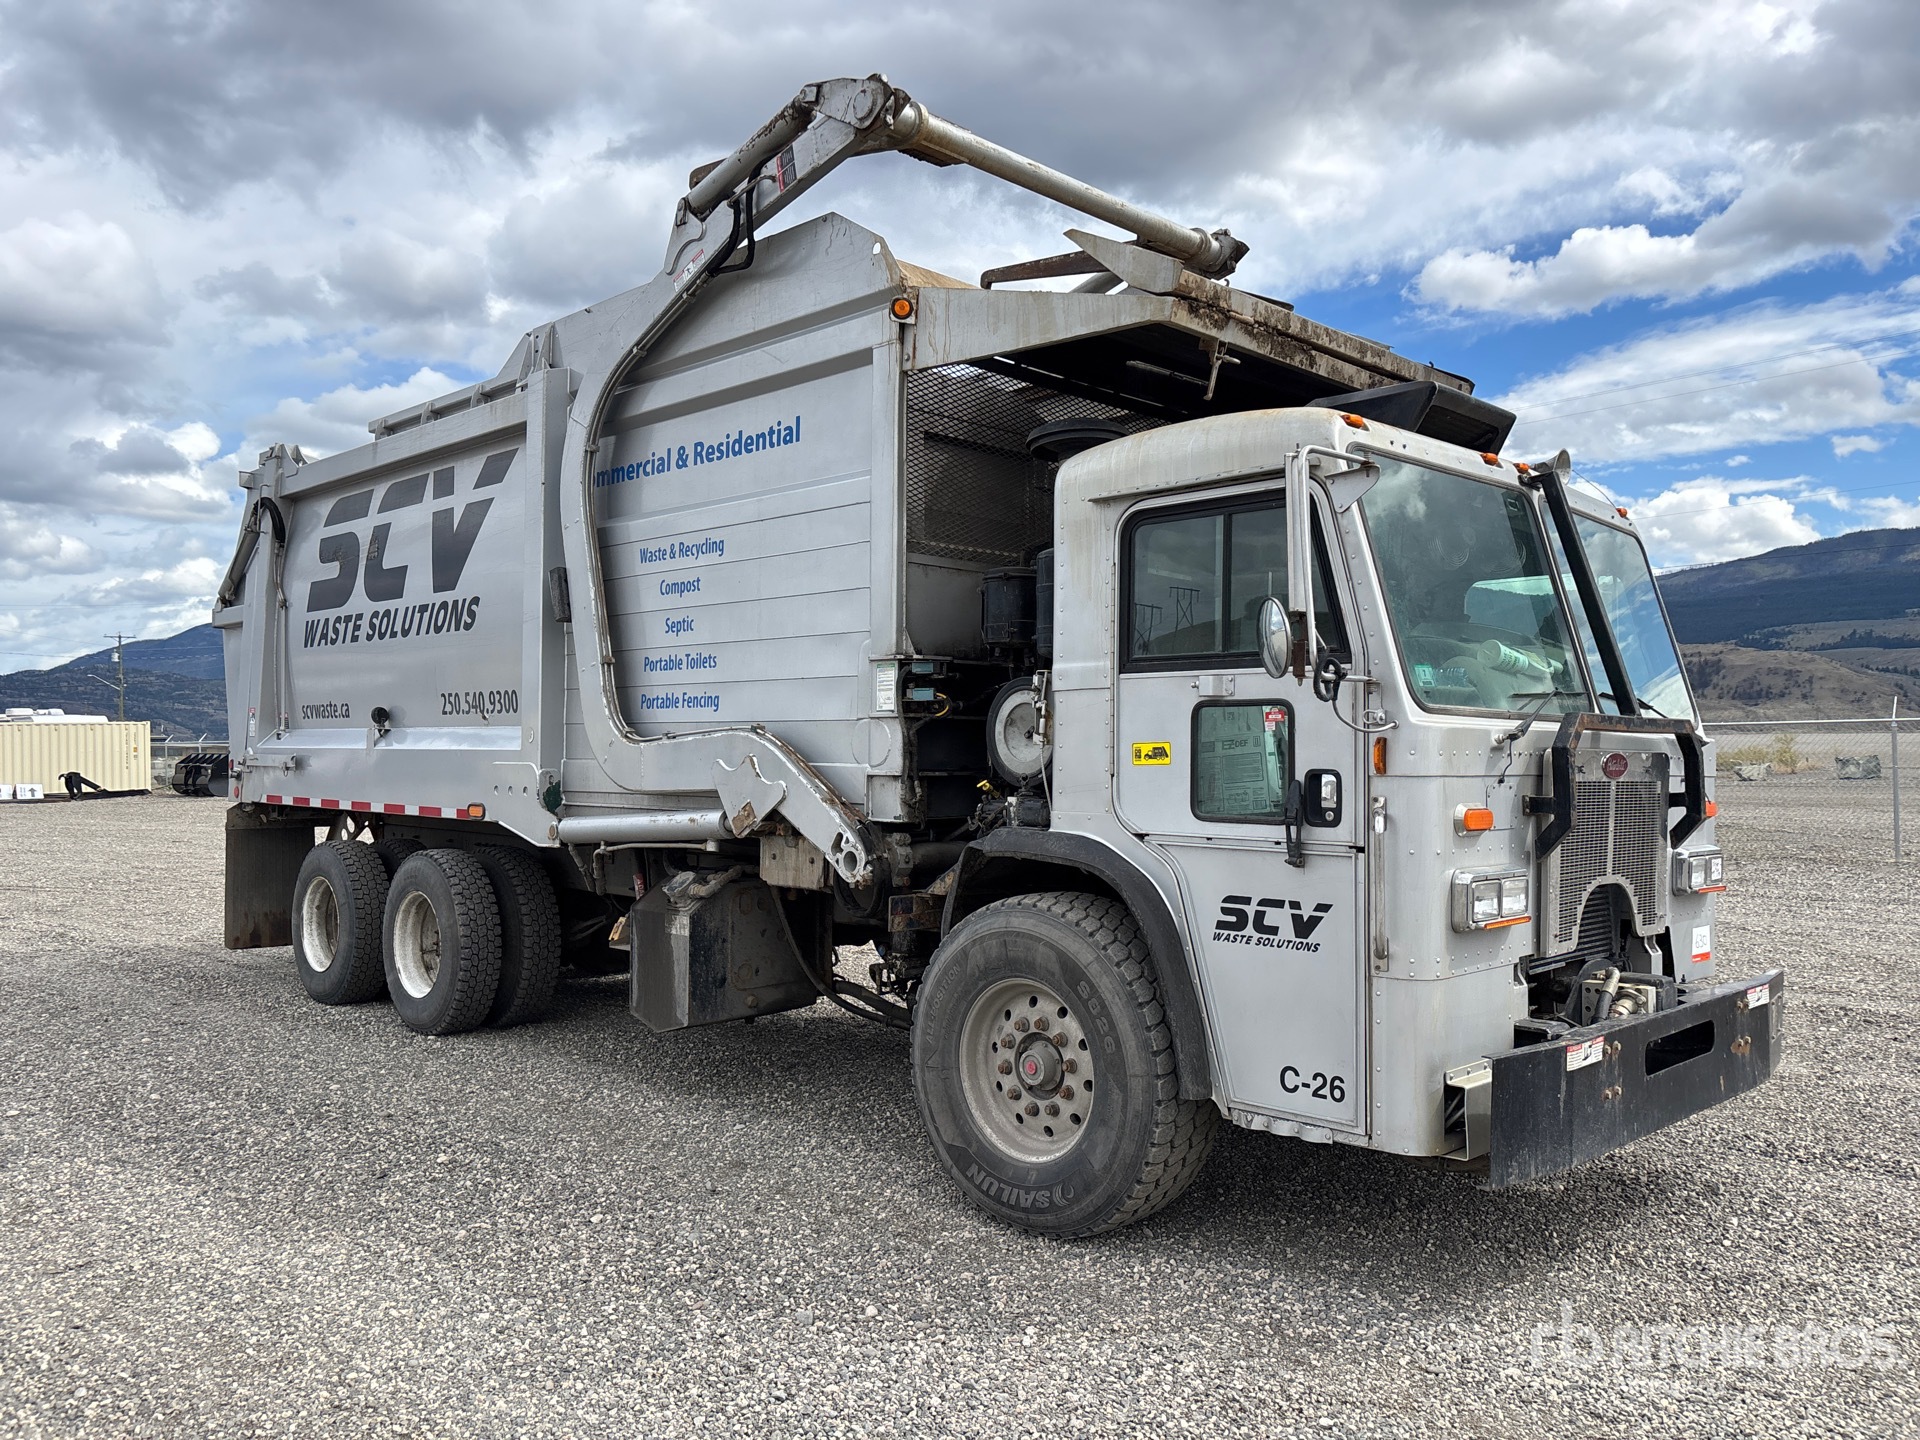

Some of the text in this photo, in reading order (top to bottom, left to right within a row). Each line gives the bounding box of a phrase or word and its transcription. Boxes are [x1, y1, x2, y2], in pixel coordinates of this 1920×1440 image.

[594, 415, 801, 487] mmercial & Residential
[306, 447, 520, 613] SCV
[639, 537, 725, 564] Waste & Recycling
[659, 577, 701, 597] Compost
[303, 595, 481, 649] WASTE SOLUTIONS
[664, 616, 695, 637] Septic
[643, 651, 718, 673] Portable Toilets
[301, 701, 351, 720] scvwaste.ca
[440, 689, 519, 716] 250.540.9300
[640, 691, 720, 714] Portable Fencing
[1213, 895, 1334, 940] SCV
[1212, 931, 1321, 953] WASTE SOLUTIONS
[1279, 1066, 1346, 1103] C-26
[965, 1162, 1051, 1209] SAILUN
